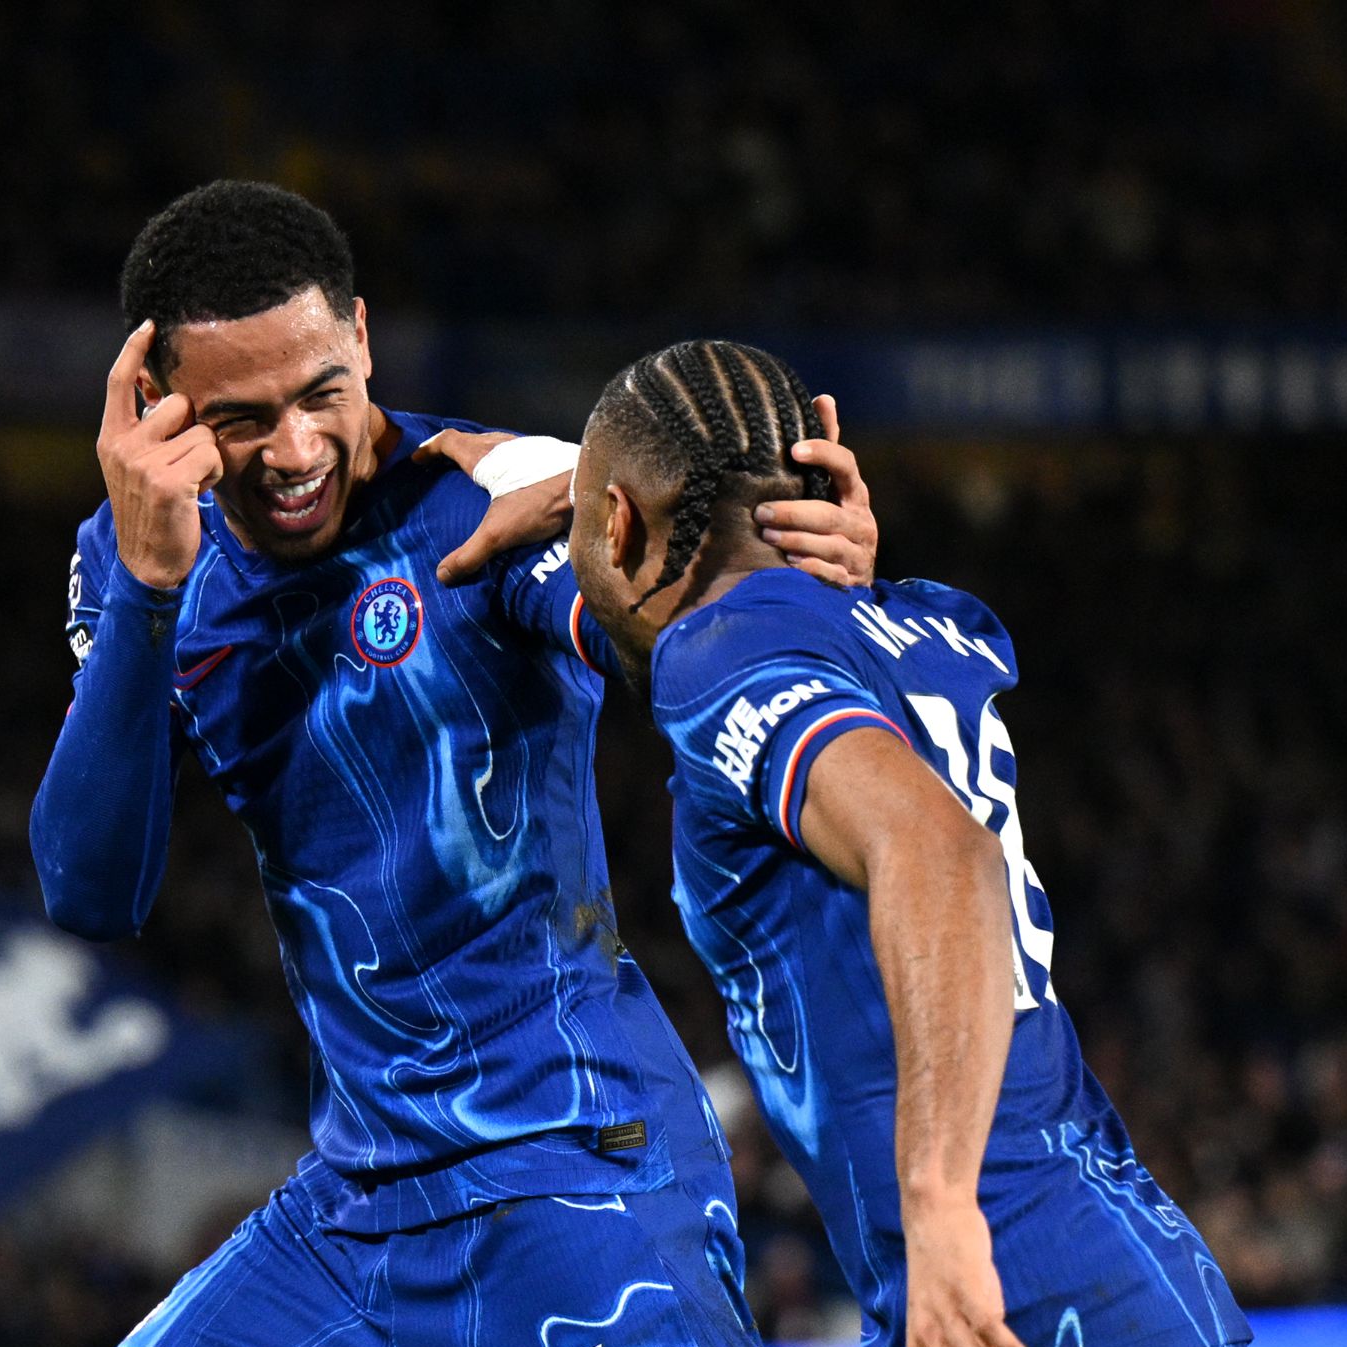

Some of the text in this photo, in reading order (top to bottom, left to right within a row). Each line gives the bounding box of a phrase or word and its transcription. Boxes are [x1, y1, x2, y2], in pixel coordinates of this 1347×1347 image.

[364, 583, 407, 603] CHELSEA
[713, 696, 758, 779] LIVE
[730, 680, 831, 795] NATION
